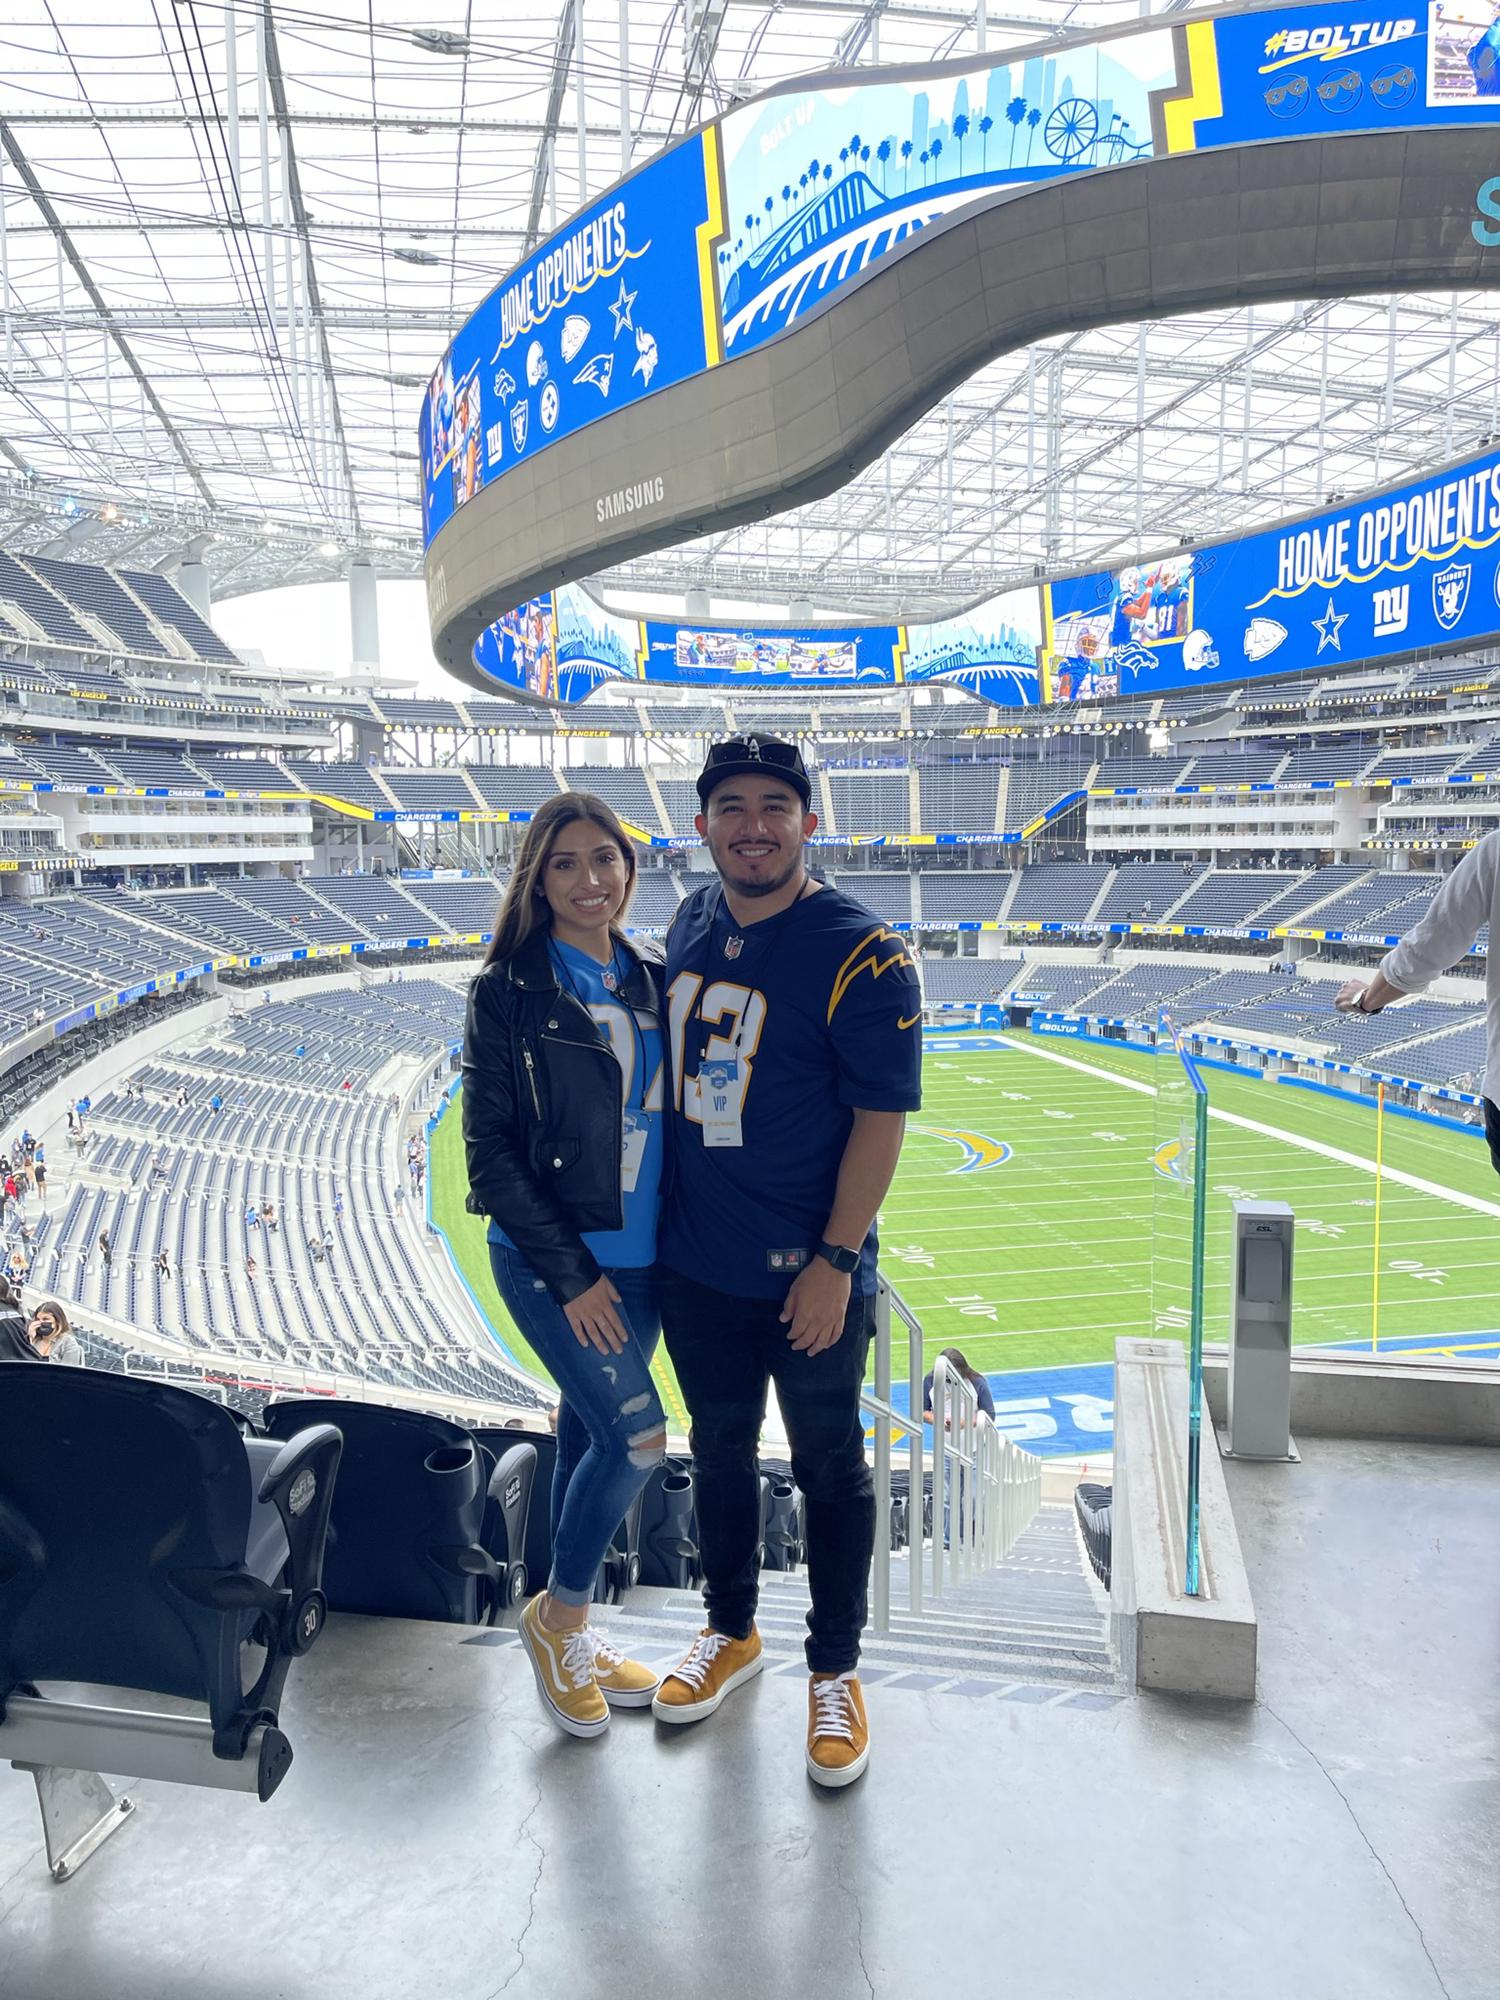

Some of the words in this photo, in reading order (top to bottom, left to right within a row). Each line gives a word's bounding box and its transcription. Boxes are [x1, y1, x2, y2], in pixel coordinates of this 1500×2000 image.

[1264, 19, 1416, 58] #BOLTUP
[501, 270, 534, 340] HOME
[536, 202, 626, 311] OPPONENTS
[596, 476, 665, 522] SAMSUNG
[1278, 519, 1351, 590] HOME
[1357, 463, 1500, 569] OPPONENTS
[1437, 569, 1467, 585] RAIDERS
[982, 727, 1023, 735] ANGELES
[53, 785, 88, 793] CHARGERS
[1273, 782, 1313, 790] CHARGERS
[168, 789, 206, 797] CHARGERS
[394, 813, 443, 821] CHARGERS
[667, 839, 703, 848] CHARGE
[956, 835, 1005, 844] CHARGERS
[634, 927, 668, 936] CHARG
[909, 922, 960, 930] CHARGERS
[1060, 923, 1111, 932] CHARGERS
[1203, 928, 1250, 938] CHARGERS
[1341, 933, 1386, 945] CHARGERS
[363, 940, 408, 952] CHARGERS
[260, 952, 294, 965] CHARGERS
[1039, 1023, 1078, 1034] #BOLTUP
[666, 970, 768, 1125] 13
[713, 1095, 727, 1112] VIP
[289, 1478, 307, 1502] SoFi
[304, 1609, 316, 1636] 30
